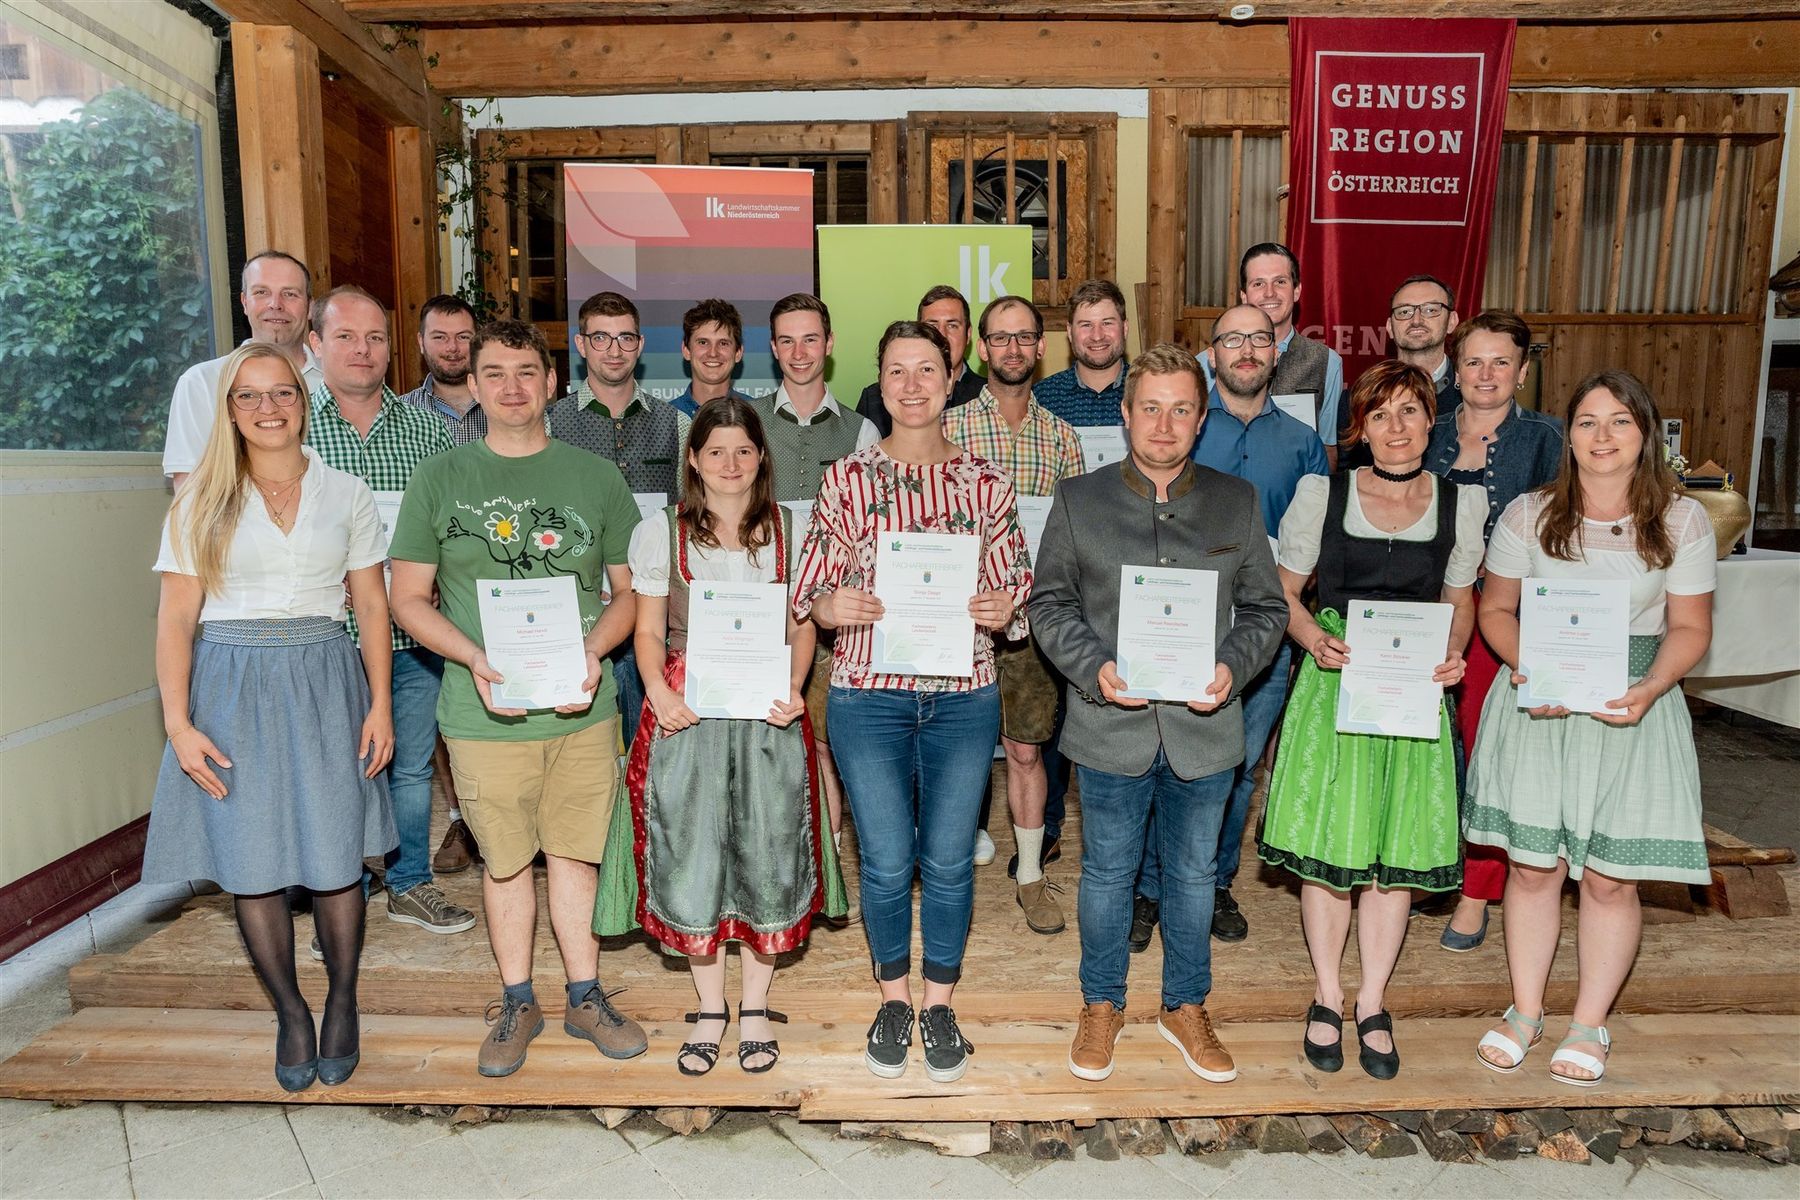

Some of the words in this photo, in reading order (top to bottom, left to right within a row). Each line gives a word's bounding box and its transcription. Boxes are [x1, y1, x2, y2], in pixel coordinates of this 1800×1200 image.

[1331, 83, 1467, 110] GENUSS
[1329, 127, 1463, 154] REGION
[1327, 169, 1460, 194] ÖSTERREICH
[706, 197, 725, 218] lk
[727, 203, 801, 212] Landwirtschaftskammer
[727, 211, 780, 219] Niederösterreich
[959, 245, 1011, 304] lk
[1300, 325, 1387, 356] GEN
[652, 387, 687, 400] BUN
